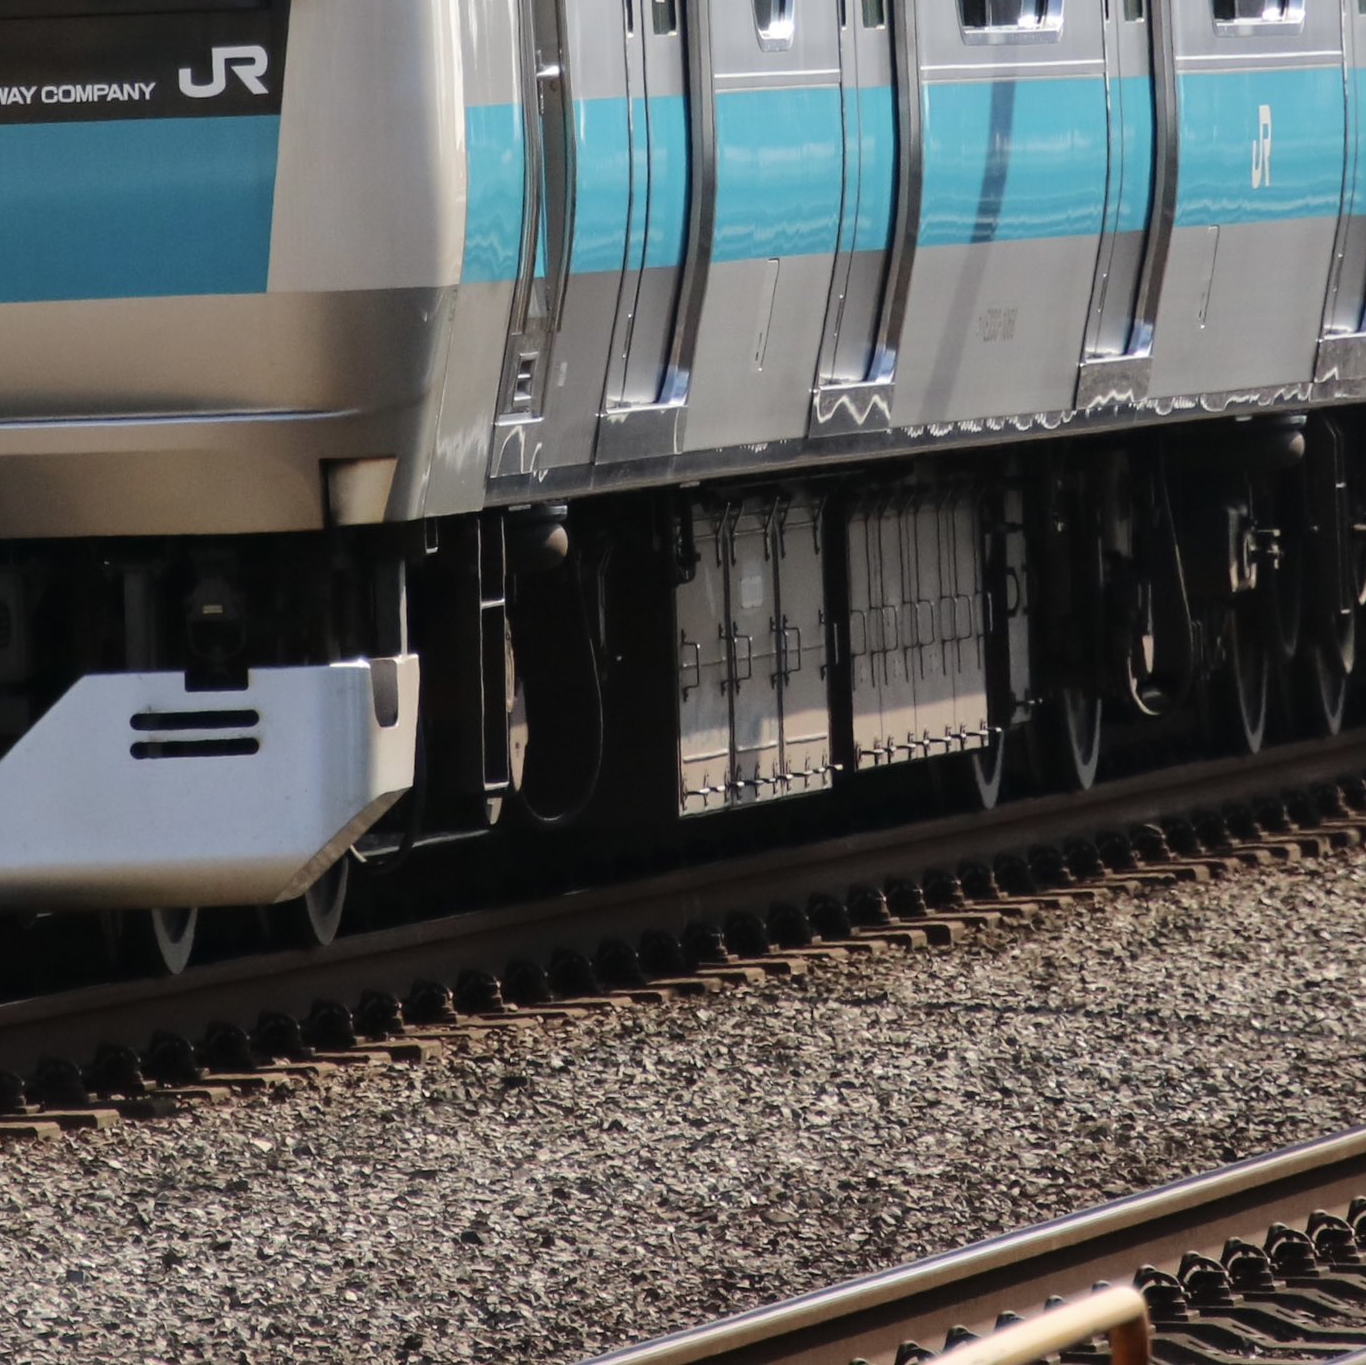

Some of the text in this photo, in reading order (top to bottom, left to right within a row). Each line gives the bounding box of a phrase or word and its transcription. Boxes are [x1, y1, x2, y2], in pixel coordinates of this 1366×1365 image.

[41, 82, 156, 104] COMPANY
[178, 45, 270, 98] JR
[1251, 104, 1272, 189] JR
